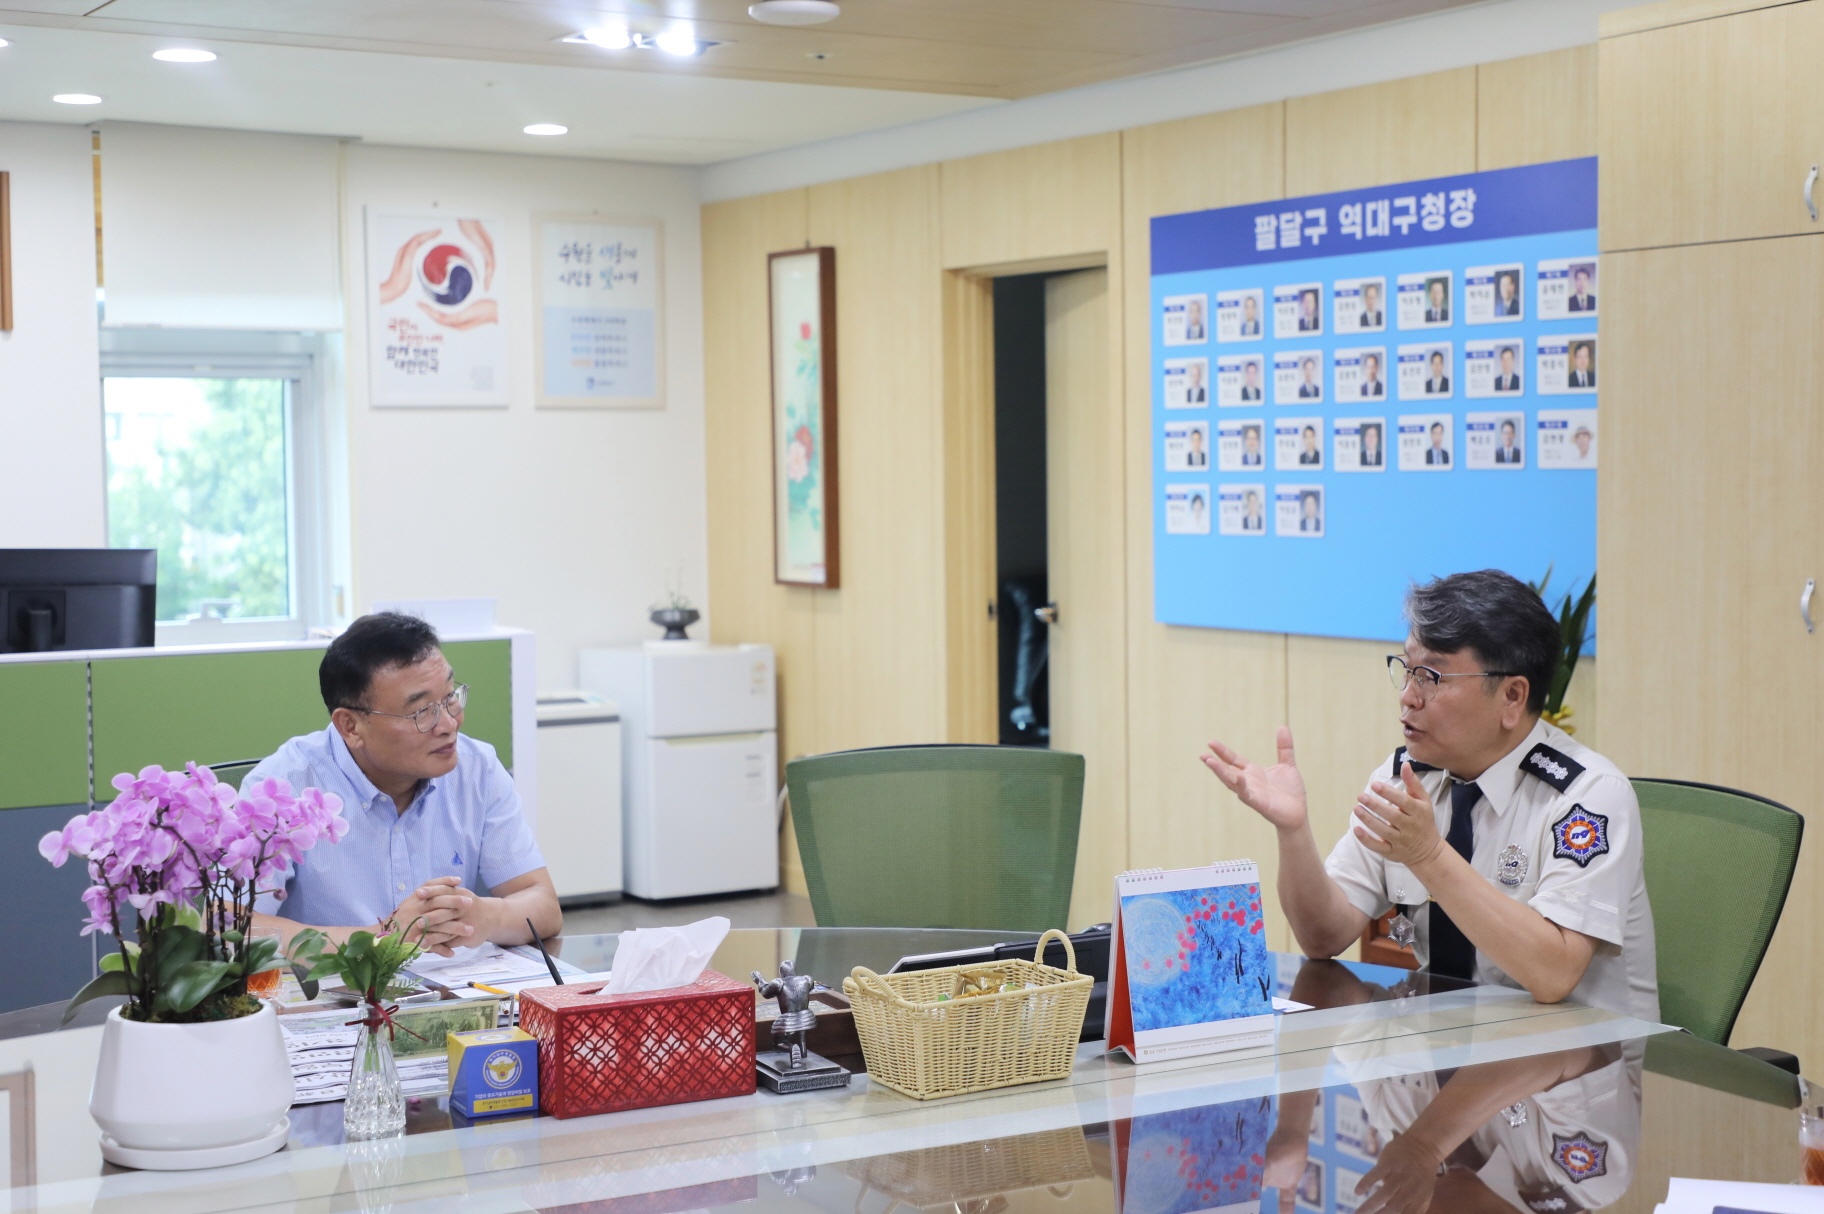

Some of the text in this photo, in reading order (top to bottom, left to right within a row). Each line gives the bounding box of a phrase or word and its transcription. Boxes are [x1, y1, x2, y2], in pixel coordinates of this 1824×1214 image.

[1254, 188, 1477, 252] 팔달구 역대구청장
[394, 359, 439, 375] 대한민국
